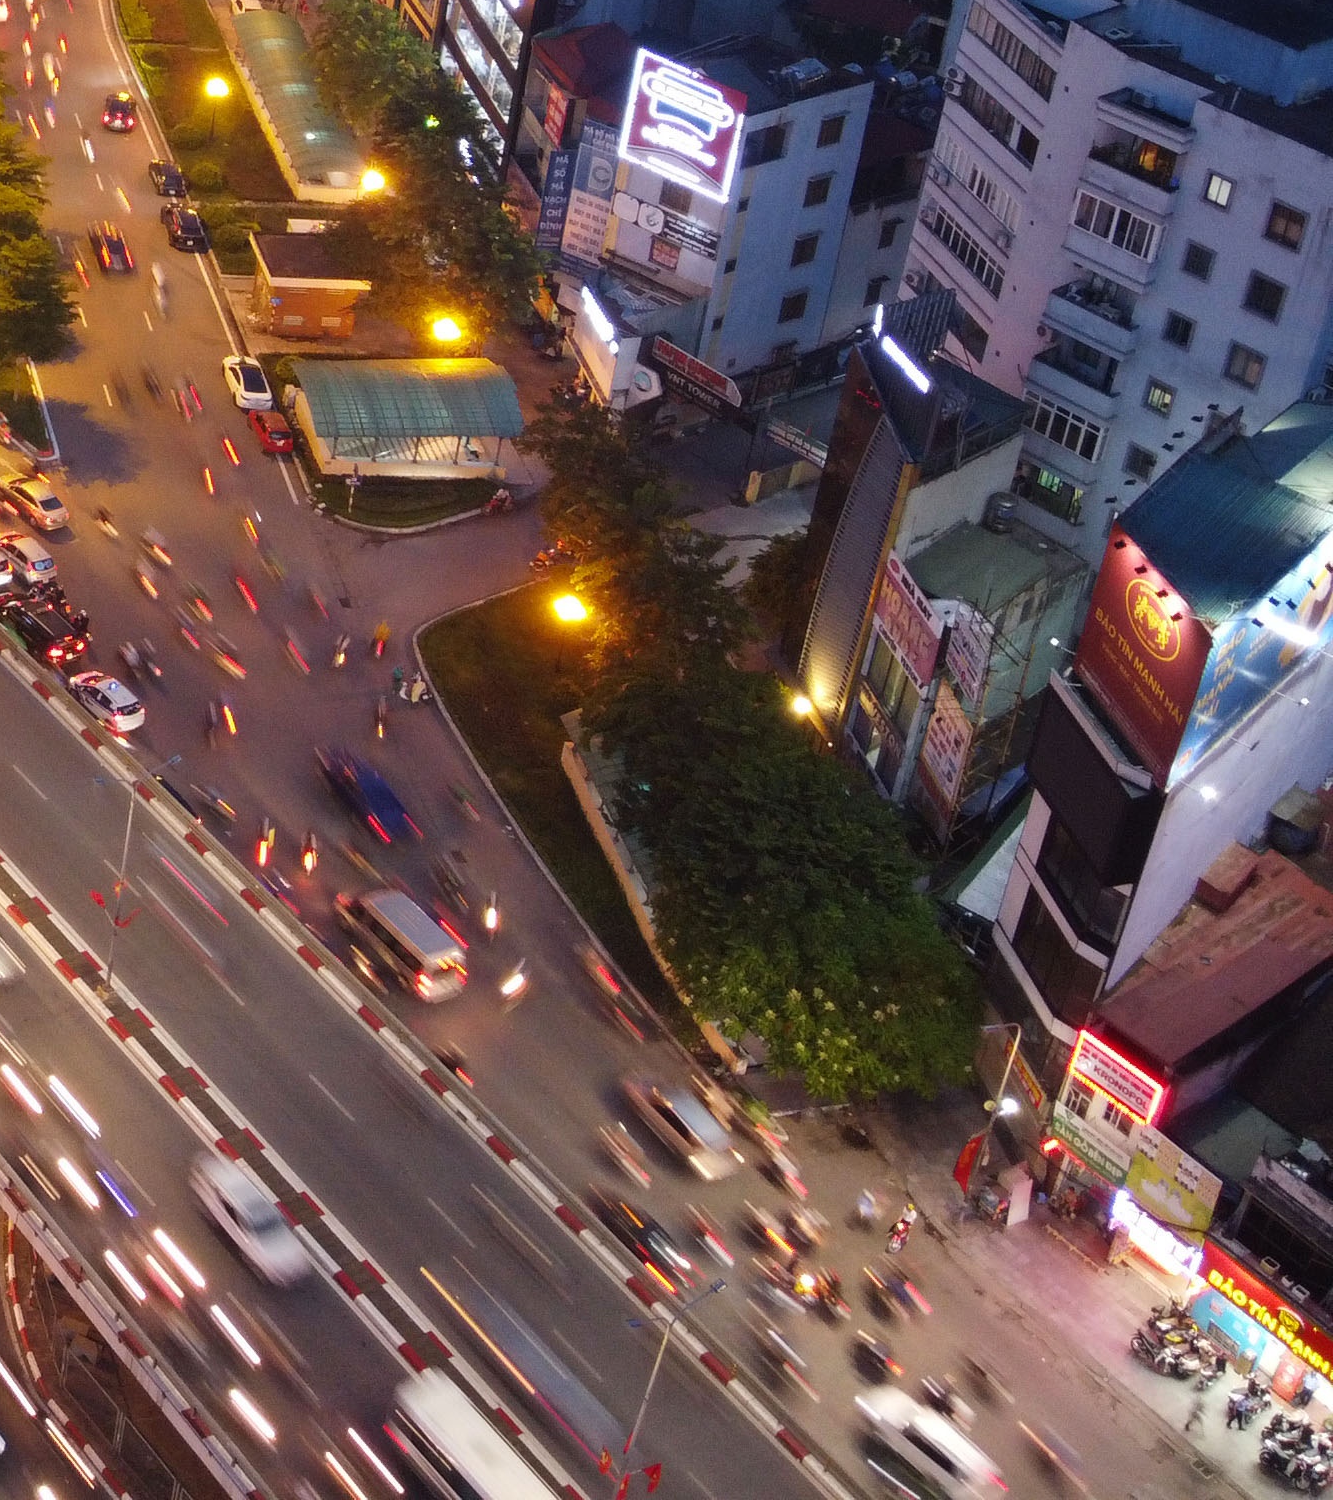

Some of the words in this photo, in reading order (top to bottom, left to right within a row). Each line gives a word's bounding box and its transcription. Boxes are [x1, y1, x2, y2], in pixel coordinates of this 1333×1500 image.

[687, 381, 722, 410] TOWER
[1117, 634, 1134, 661] TÍN
[1132, 653, 1167, 702] MẠNH
[1093, 1064, 1148, 1110] KRONOPOL
[1207, 1268, 1248, 1308] BẢO
[1247, 1299, 1277, 1332] TÍN
[1276, 1326, 1331, 1376] MẠNH
